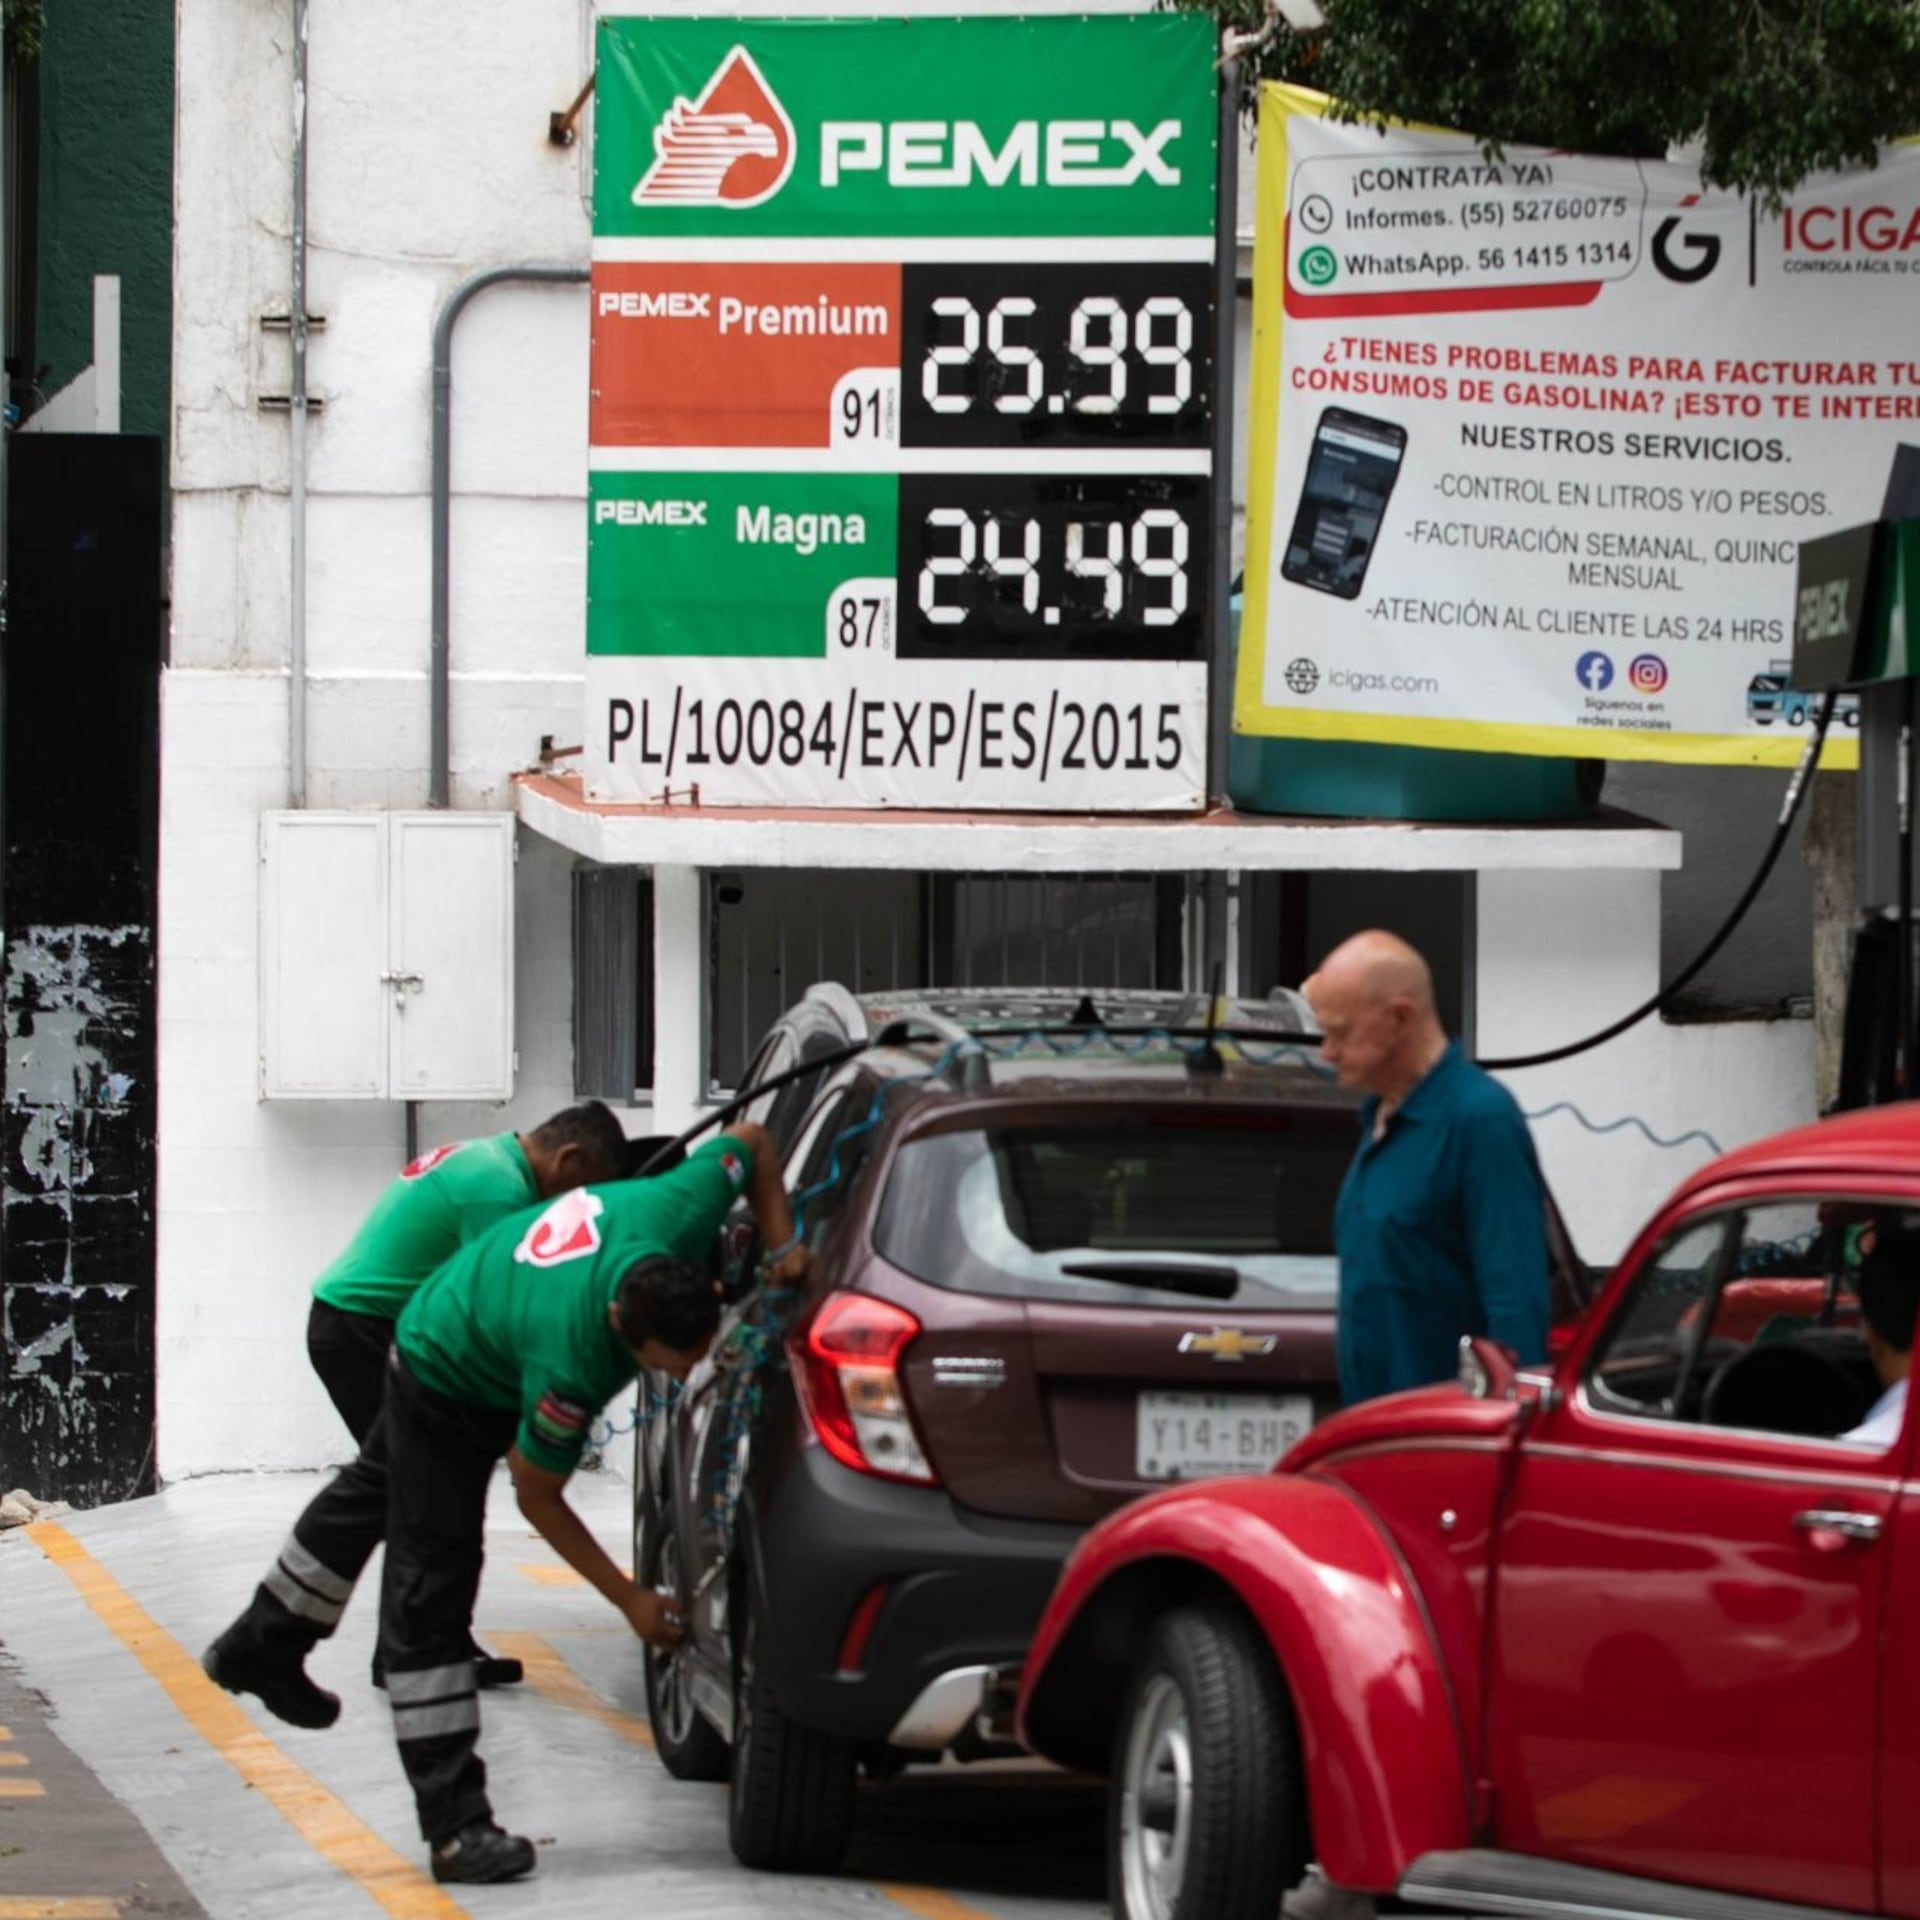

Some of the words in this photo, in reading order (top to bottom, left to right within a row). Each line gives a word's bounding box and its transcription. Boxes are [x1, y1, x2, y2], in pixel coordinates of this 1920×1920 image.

[820, 120, 1181, 187] PEMEX
[1353, 165, 1503, 196] ¡CONTRATA
[1346, 208, 1453, 230] Informes.
[1460, 202, 1504, 229] (55)
[1513, 196, 1627, 223] 52760075
[1345, 252, 1470, 277] WhatsApp.
[1479, 248, 1504, 270] 56
[1514, 245, 1568, 268] 1415
[1578, 241, 1632, 264] 1314
[1783, 259, 1851, 274] CONTROLA
[599, 292, 710, 318] PEMEX
[719, 296, 888, 336] Premium
[922, 297, 1193, 414] 25.99
[1323, 336, 1438, 365] ¿TIENES
[1448, 344, 1618, 378] PROBLEMAS
[1628, 356, 1704, 383] PARA
[1715, 359, 1877, 386] FACTURAR
[843, 387, 880, 439] 91
[1292, 366, 1448, 400] CONSUMOS
[1458, 379, 1494, 402] DE
[1503, 382, 1664, 414] GASOLINA?
[1675, 392, 1762, 420] ¡ESTO
[1773, 396, 1811, 418] TE
[1821, 396, 1920, 419] INTER
[1461, 422, 1615, 456] NUESTROS
[1624, 432, 1792, 463] SERVICIOS.
[1433, 472, 1551, 504] -CONTROL
[1558, 481, 1590, 506] EN
[1597, 484, 1683, 512] LITROS
[1690, 489, 1733, 514] Y/O
[1740, 490, 1833, 516] PESOS.
[596, 501, 707, 525] PEMEX
[736, 505, 866, 555] Magna
[1404, 519, 1579, 555] -FACTURACIÓN
[1586, 531, 1708, 565] SEMANAL,
[1715, 538, 1796, 565] QUINC
[918, 508, 1189, 624] 24.49
[1568, 562, 1684, 590] MENSUAL
[839, 597, 881, 649] 87
[1365, 597, 1498, 628] -ATENCIÓN
[1503, 607, 1531, 631] AL
[1537, 608, 1636, 638] CLIENTE
[1643, 616, 1689, 641] LAS
[1696, 616, 1723, 641] 24
[1731, 618, 1784, 644] HRS
[1328, 668, 1439, 694] icigas.com
[608, 686, 1182, 782] PL/10084/EXP/ES/2015
